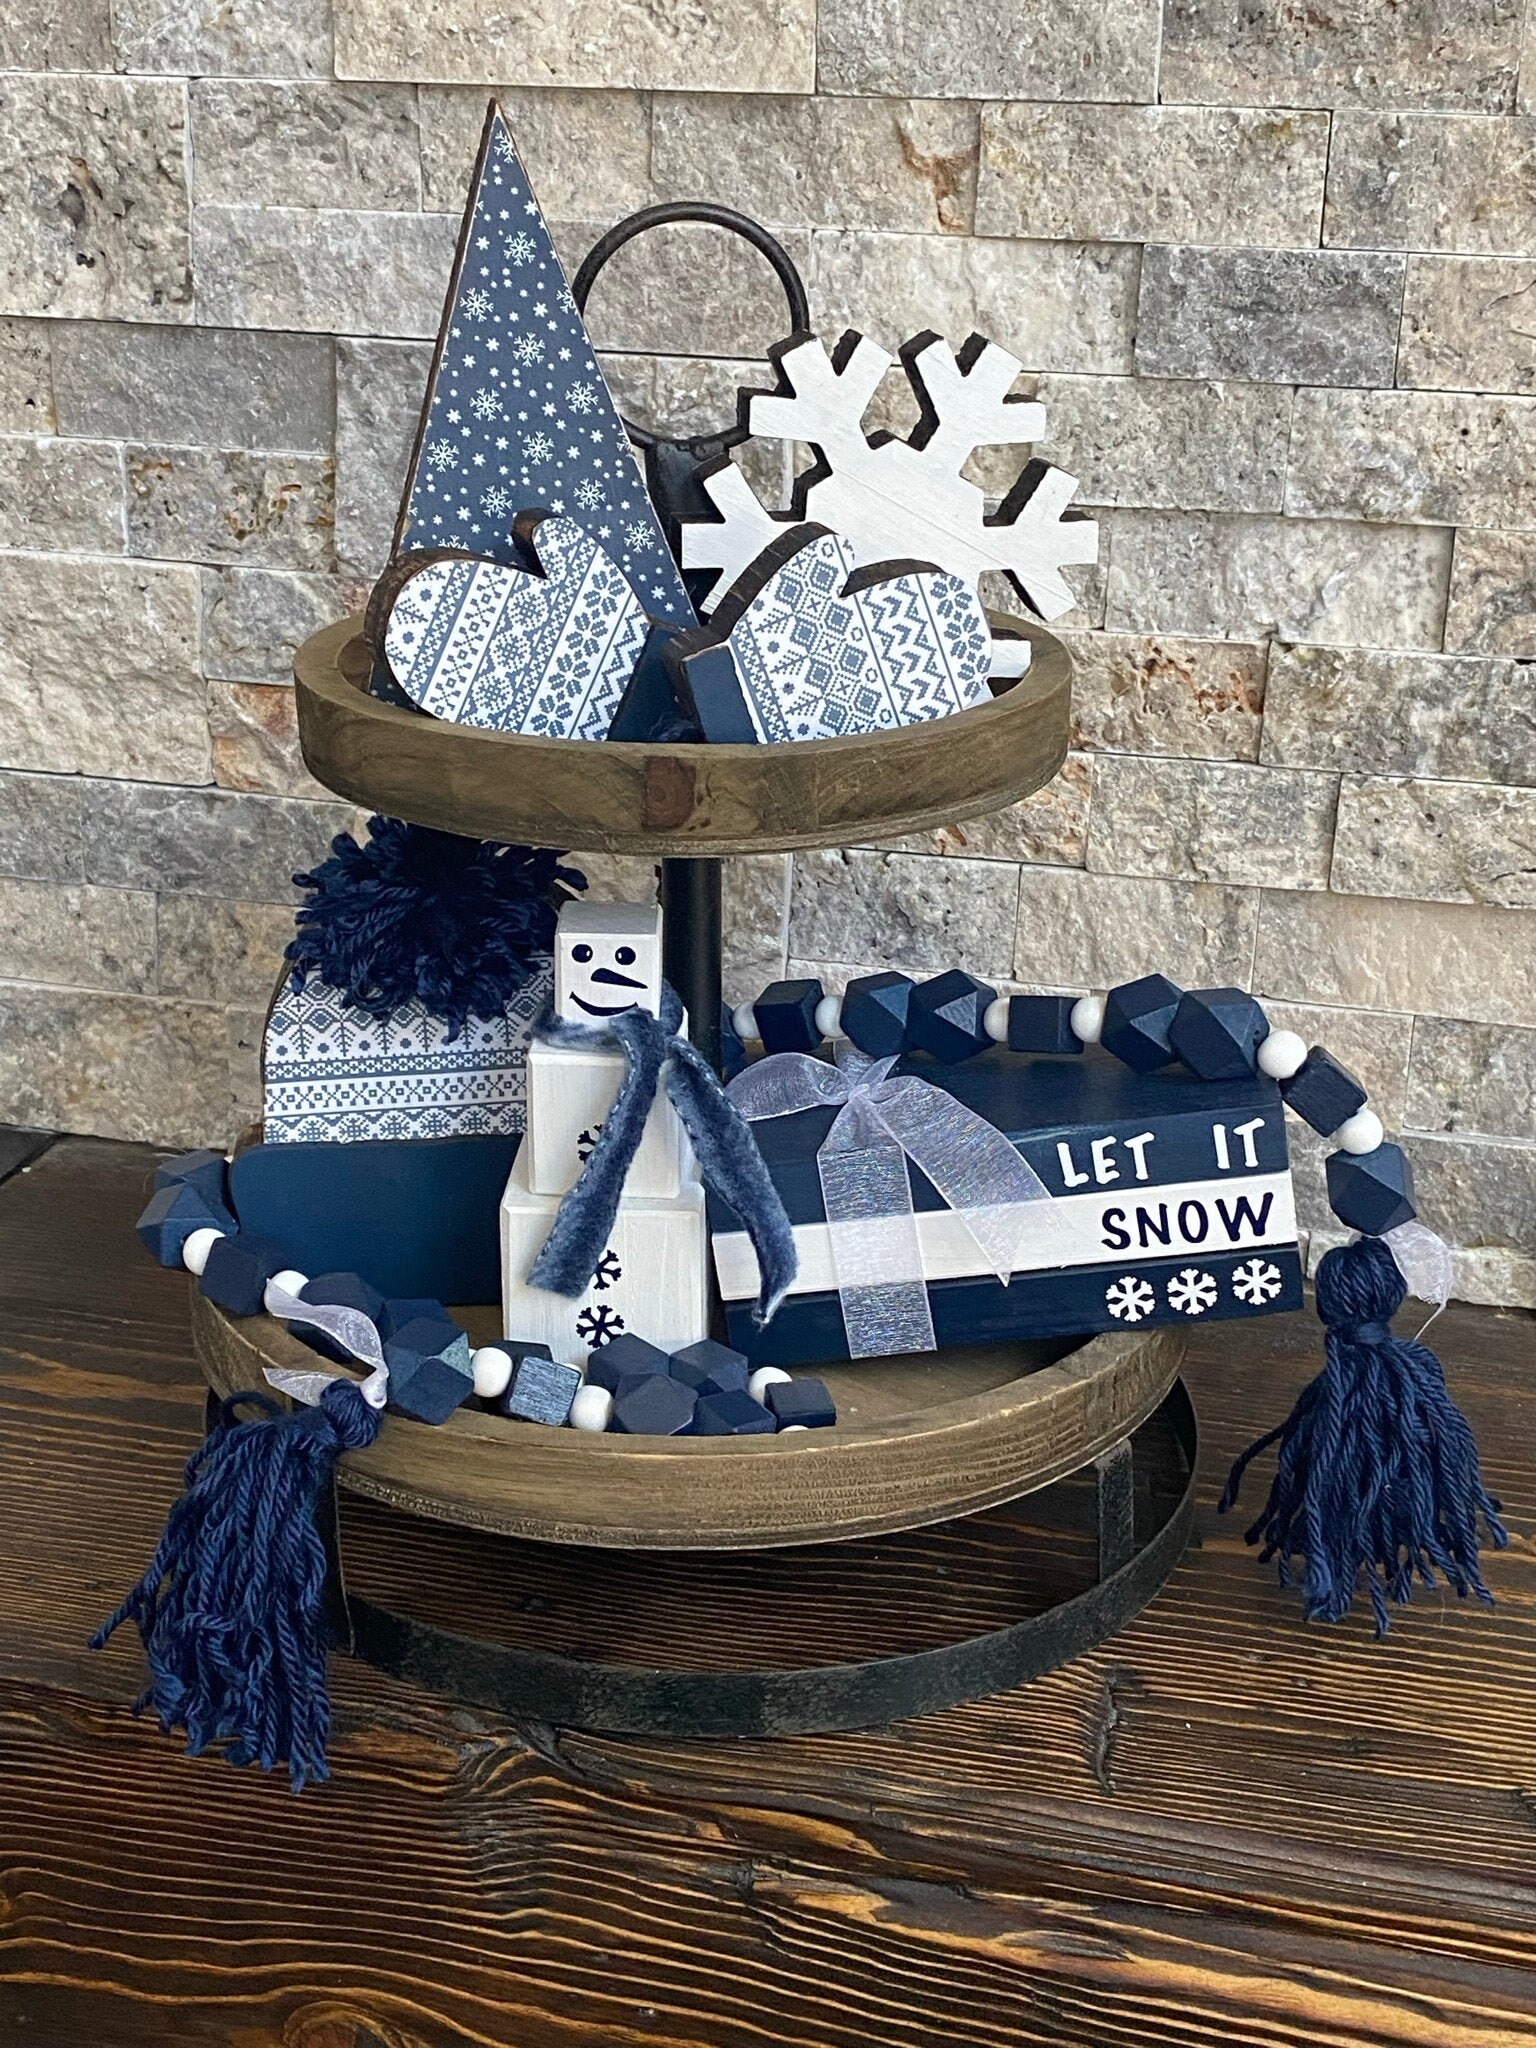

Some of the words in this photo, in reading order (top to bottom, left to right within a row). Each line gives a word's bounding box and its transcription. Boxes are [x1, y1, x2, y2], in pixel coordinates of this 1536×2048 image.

[1056, 1131, 1155, 1188] LET
[1212, 1117, 1266, 1170] IT
[1100, 1191, 1275, 1250] SNOW
